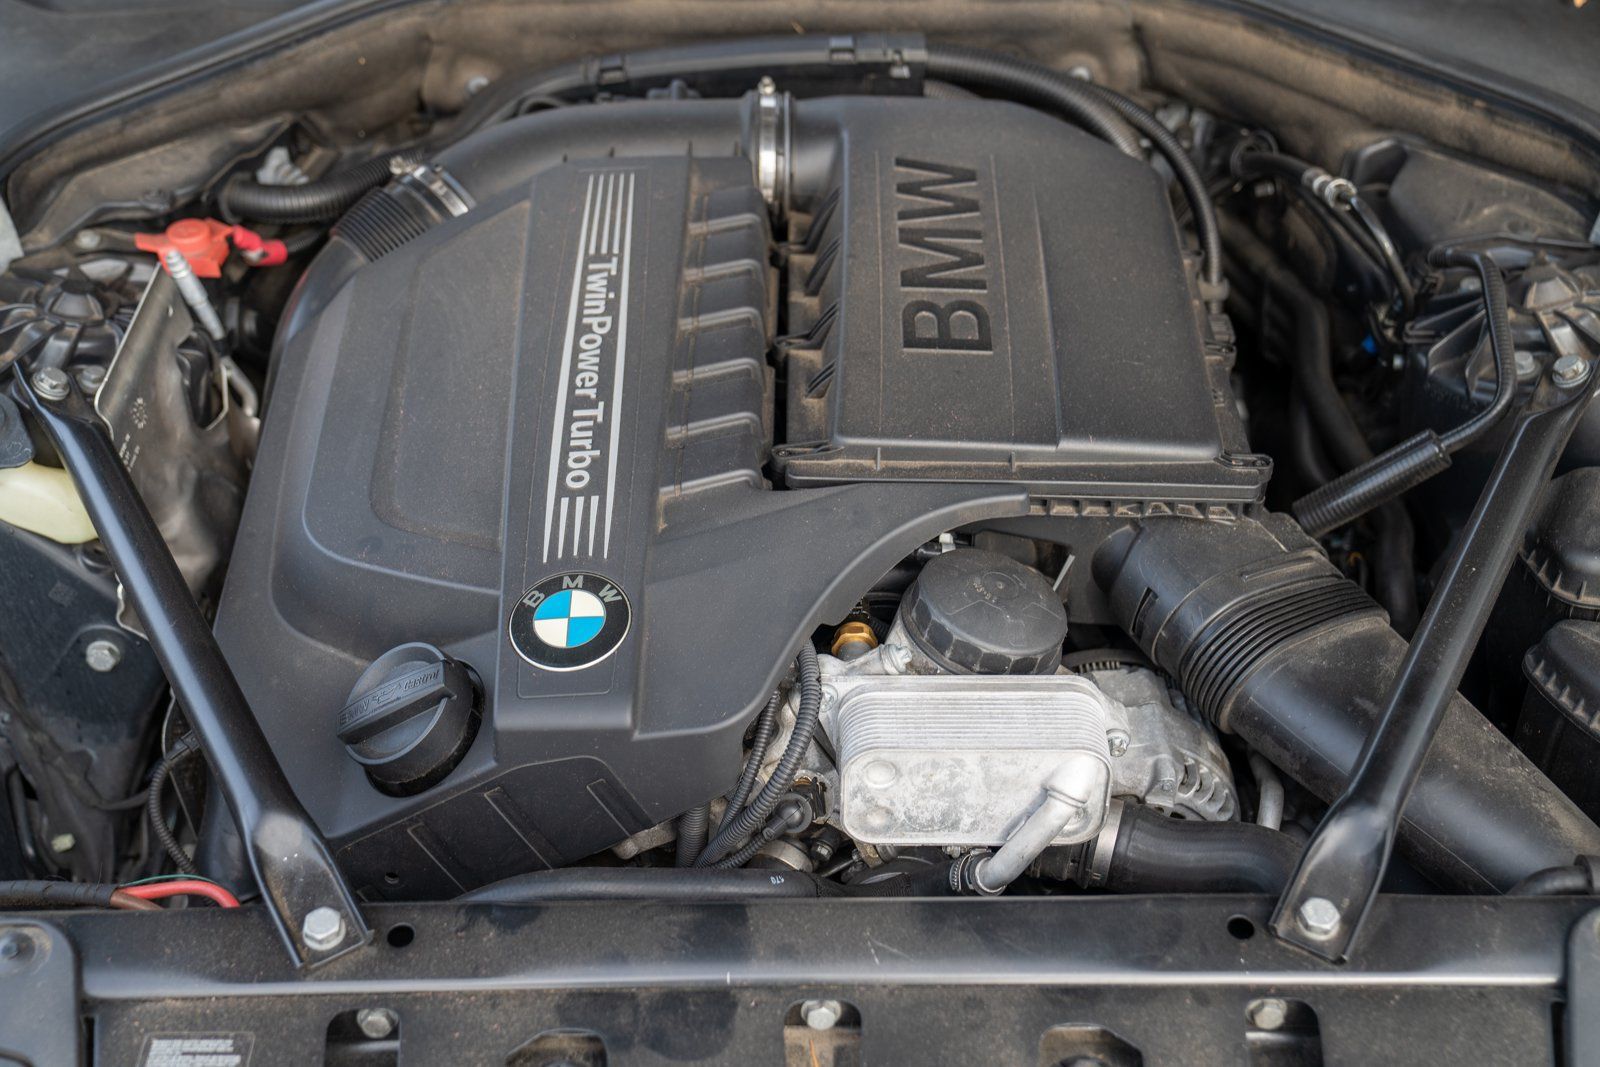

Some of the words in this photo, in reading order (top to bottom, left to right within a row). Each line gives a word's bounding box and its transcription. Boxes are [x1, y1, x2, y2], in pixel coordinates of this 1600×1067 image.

[894, 156, 994, 355] BMW
[574, 256, 618, 399] TwinPower
[565, 401, 605, 489] Turbo
[522, 574, 622, 608] BMW
